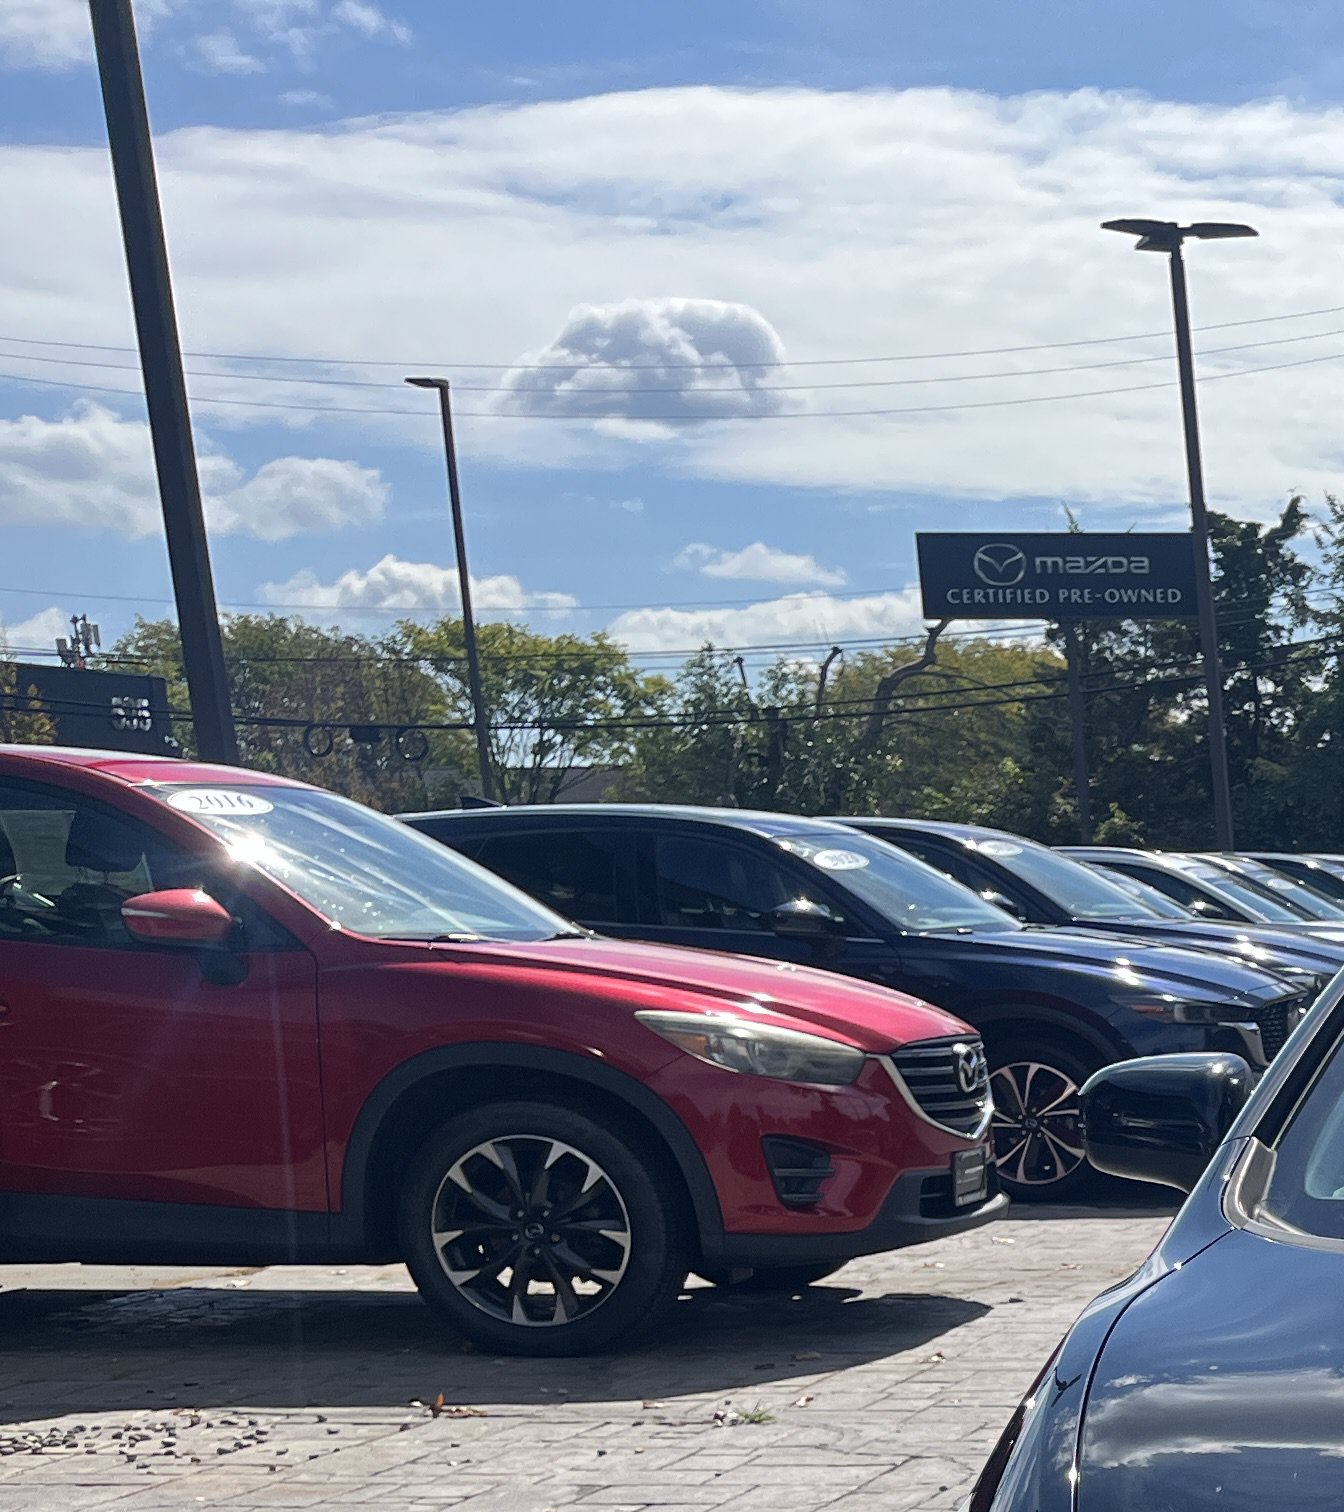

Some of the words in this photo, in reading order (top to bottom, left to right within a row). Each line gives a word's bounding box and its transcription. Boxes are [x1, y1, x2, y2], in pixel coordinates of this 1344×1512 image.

[1035, 556, 1150, 575] mazda
[946, 588, 1050, 604] CERTIFIED
[1058, 588, 1182, 603] PRE-OWNED
[188, 794, 255, 810] 2016
